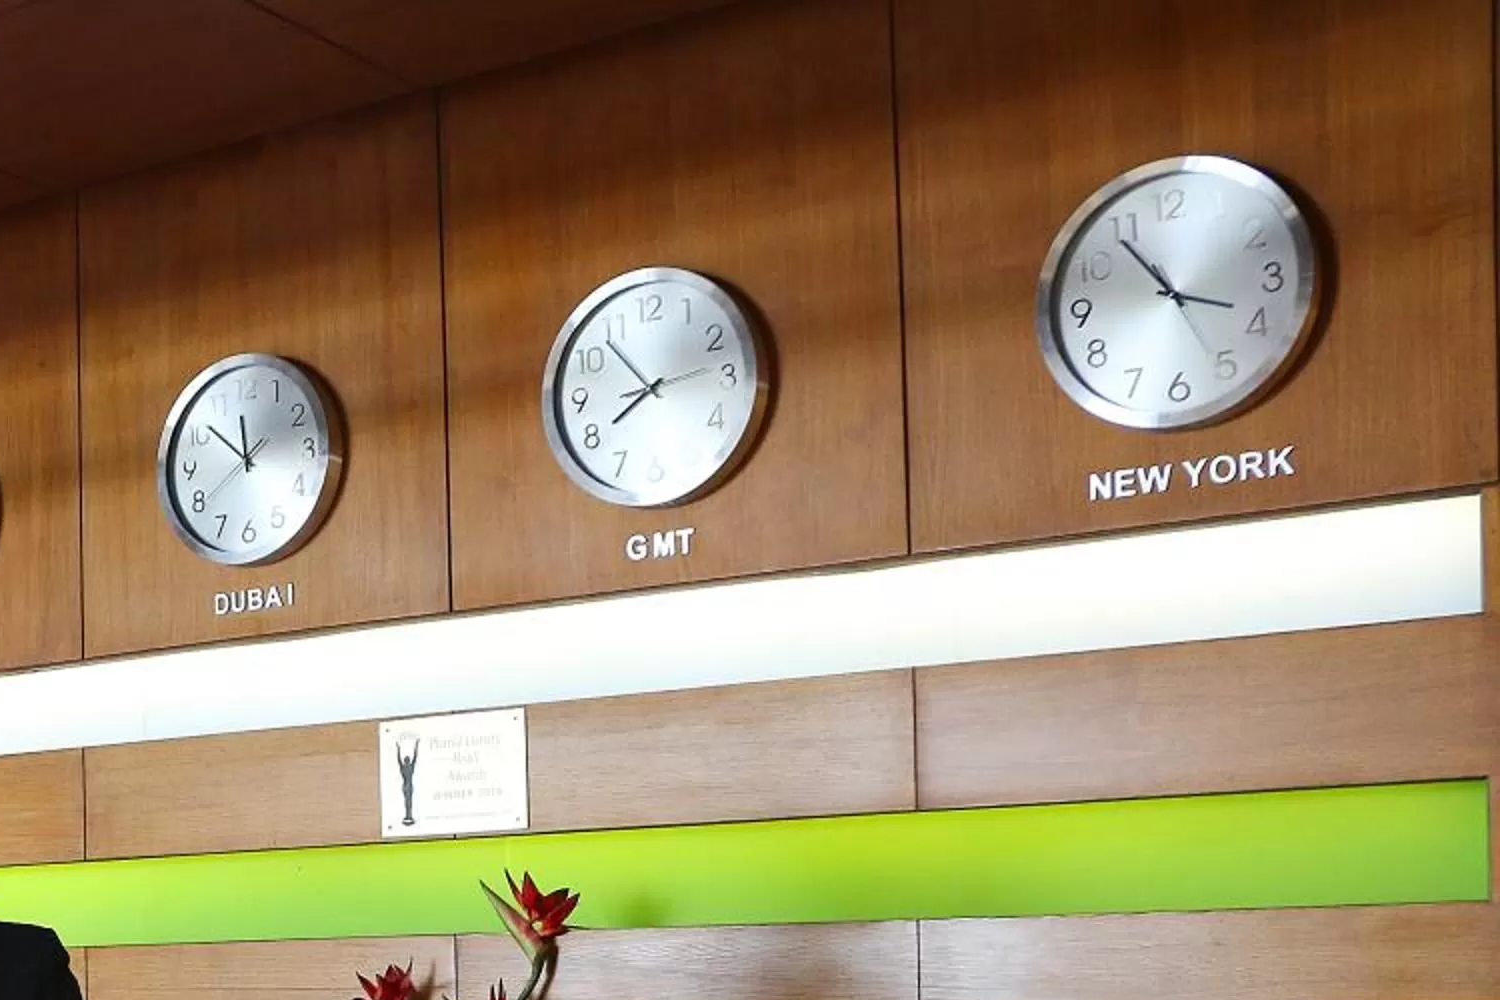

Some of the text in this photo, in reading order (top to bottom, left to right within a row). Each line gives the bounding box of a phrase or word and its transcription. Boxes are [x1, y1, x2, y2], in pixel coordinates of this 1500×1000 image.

[1151, 189, 1185, 222] 12
[1108, 213, 1139, 243] 11
[1074, 251, 1113, 284] 10
[1261, 260, 1283, 293] 3
[636, 294, 664, 323] 12
[682, 297, 692, 325] 1
[1070, 298, 1093, 329] 9
[1245, 306, 1268, 338] 4
[604, 314, 627, 342] 11
[705, 323, 725, 352] 2
[575, 346, 605, 375] 10
[1086, 339, 1108, 369] 8
[1214, 350, 1238, 381] 5
[271, 379, 281, 403] 1
[719, 363, 737, 390] 3
[1124, 367, 1144, 399] 7
[1167, 371, 1191, 403] 6
[291, 403, 306, 427] 2
[571, 387, 589, 414] 9
[707, 402, 725, 429] 4
[303, 437, 316, 458] 3
[583, 423, 601, 450] 8
[183, 460, 197, 481] 9
[612, 450, 628, 479] 7
[1087, 446, 1296, 502] NEW YORK
[191, 489, 205, 513] 8
[214, 514, 228, 539] 7
[270, 504, 286, 529] 5
[241, 519, 257, 544] 6
[626, 527, 695, 561] GMT
[213, 583, 295, 615] DUBAI
